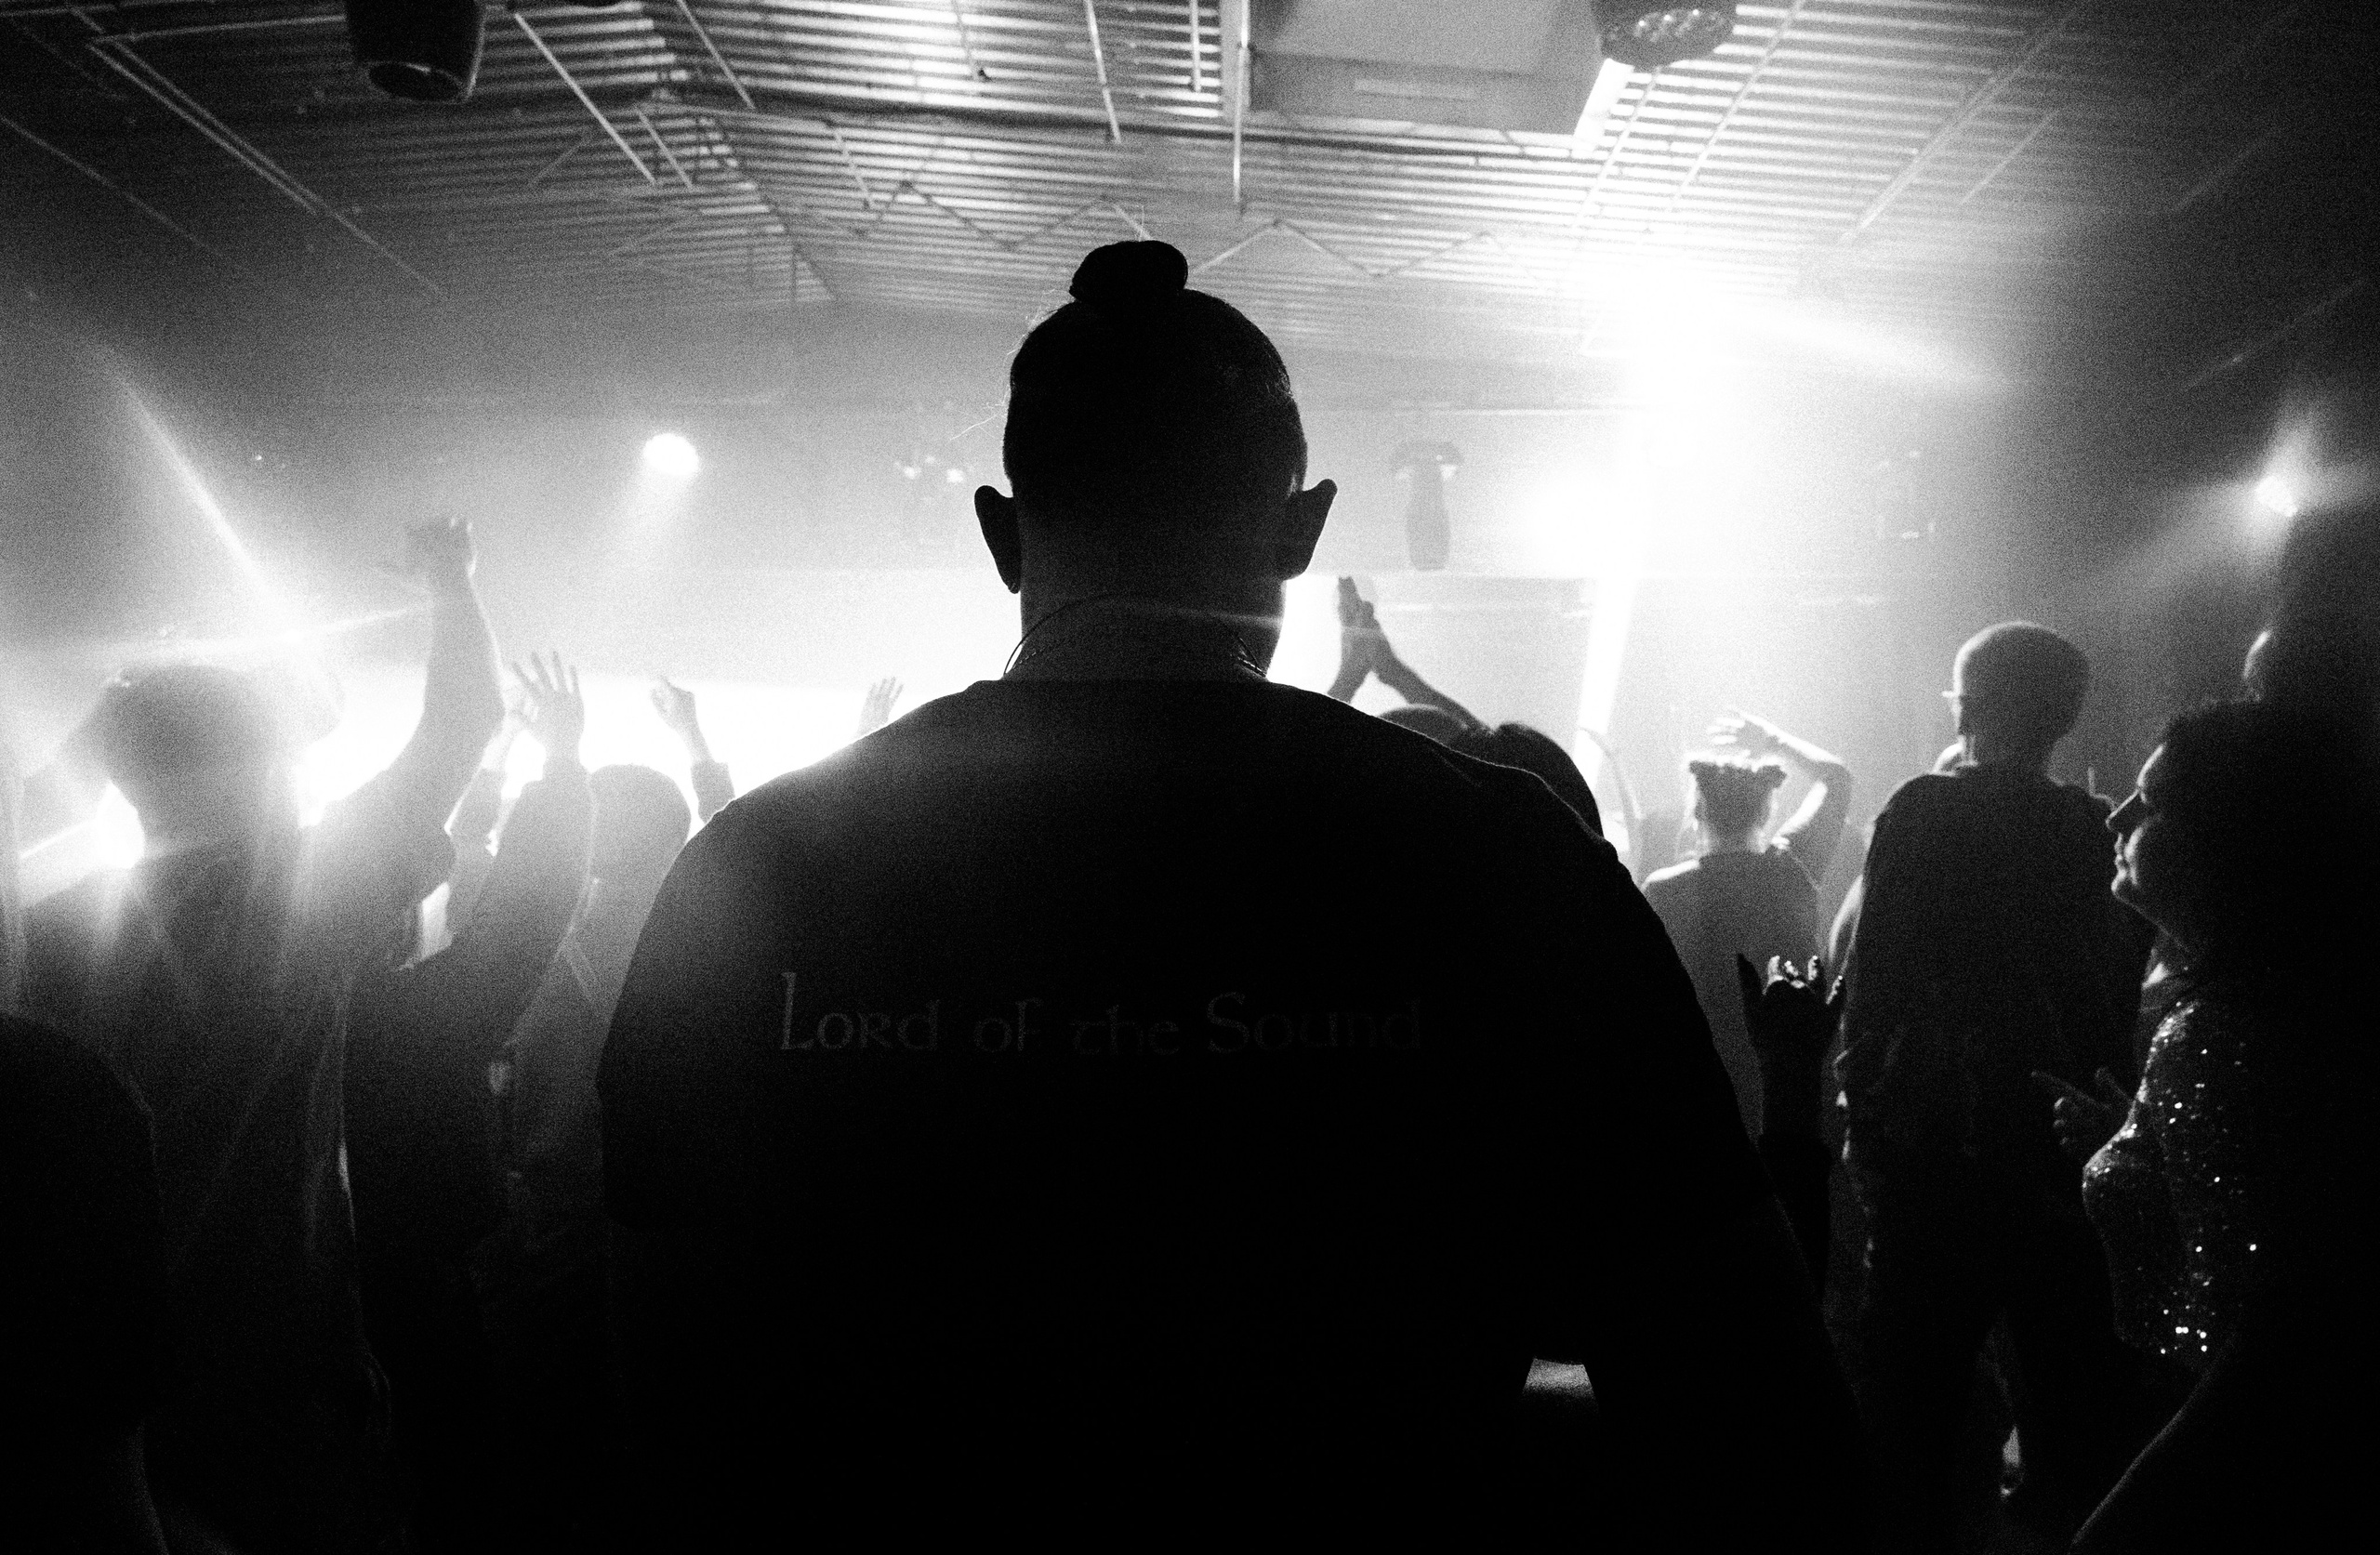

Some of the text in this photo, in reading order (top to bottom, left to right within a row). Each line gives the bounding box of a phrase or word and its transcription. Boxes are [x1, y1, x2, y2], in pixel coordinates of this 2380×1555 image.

[973, 997, 1044, 1053] of
[1071, 1003, 1182, 1056] the
[1206, 991, 1421, 1054] Sound
